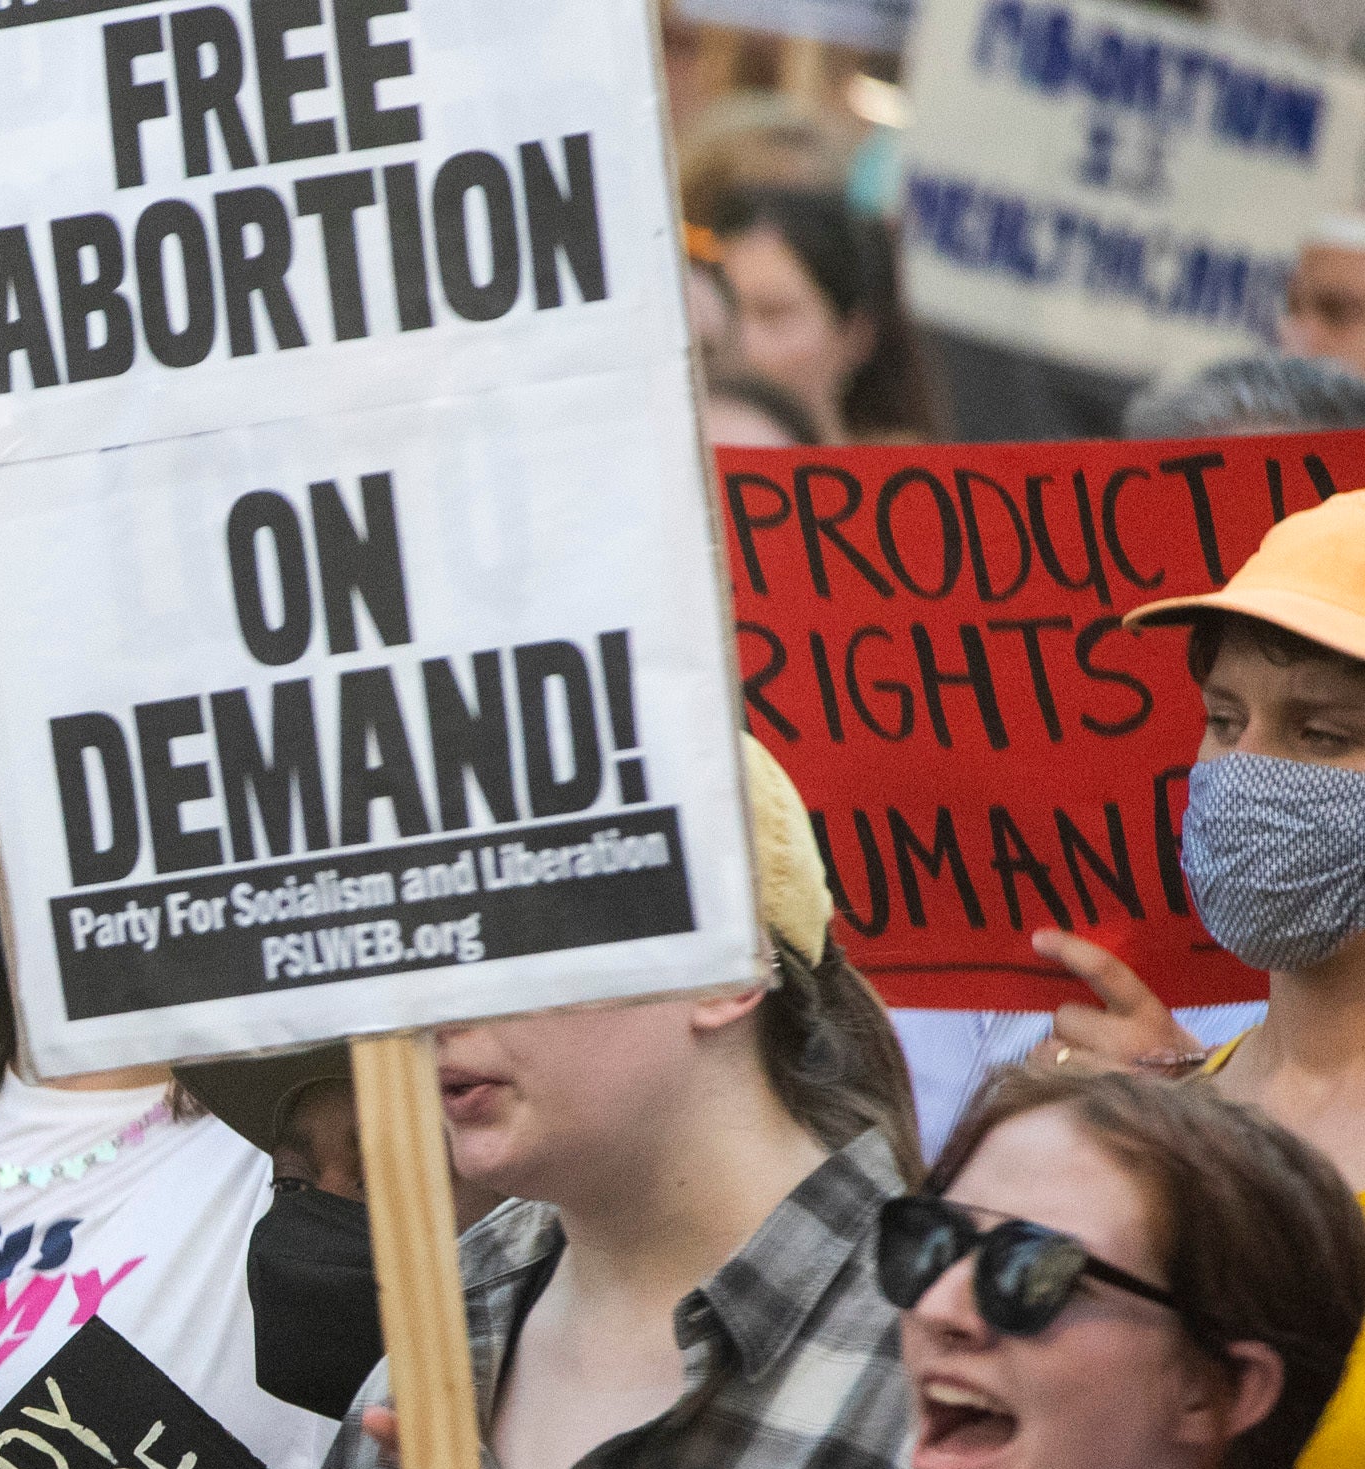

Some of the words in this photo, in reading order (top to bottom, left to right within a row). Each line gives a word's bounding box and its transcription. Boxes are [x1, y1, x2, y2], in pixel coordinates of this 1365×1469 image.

[102, 0, 423, 190] FREE
[226, 471, 413, 667] ON
[724, 452, 1339, 604] PRODUCTI
[741, 614, 1156, 751] RIGHTS
[49, 629, 651, 888] DEMAND!
[70, 900, 162, 955] Party
[165, 890, 230, 936] For
[233, 863, 395, 925] Socialism
[401, 851, 477, 904] and
[482, 829, 670, 889] Liberation
[807, 803, 1147, 937] UMAN
[262, 912, 485, 981] PSLWEB.org
